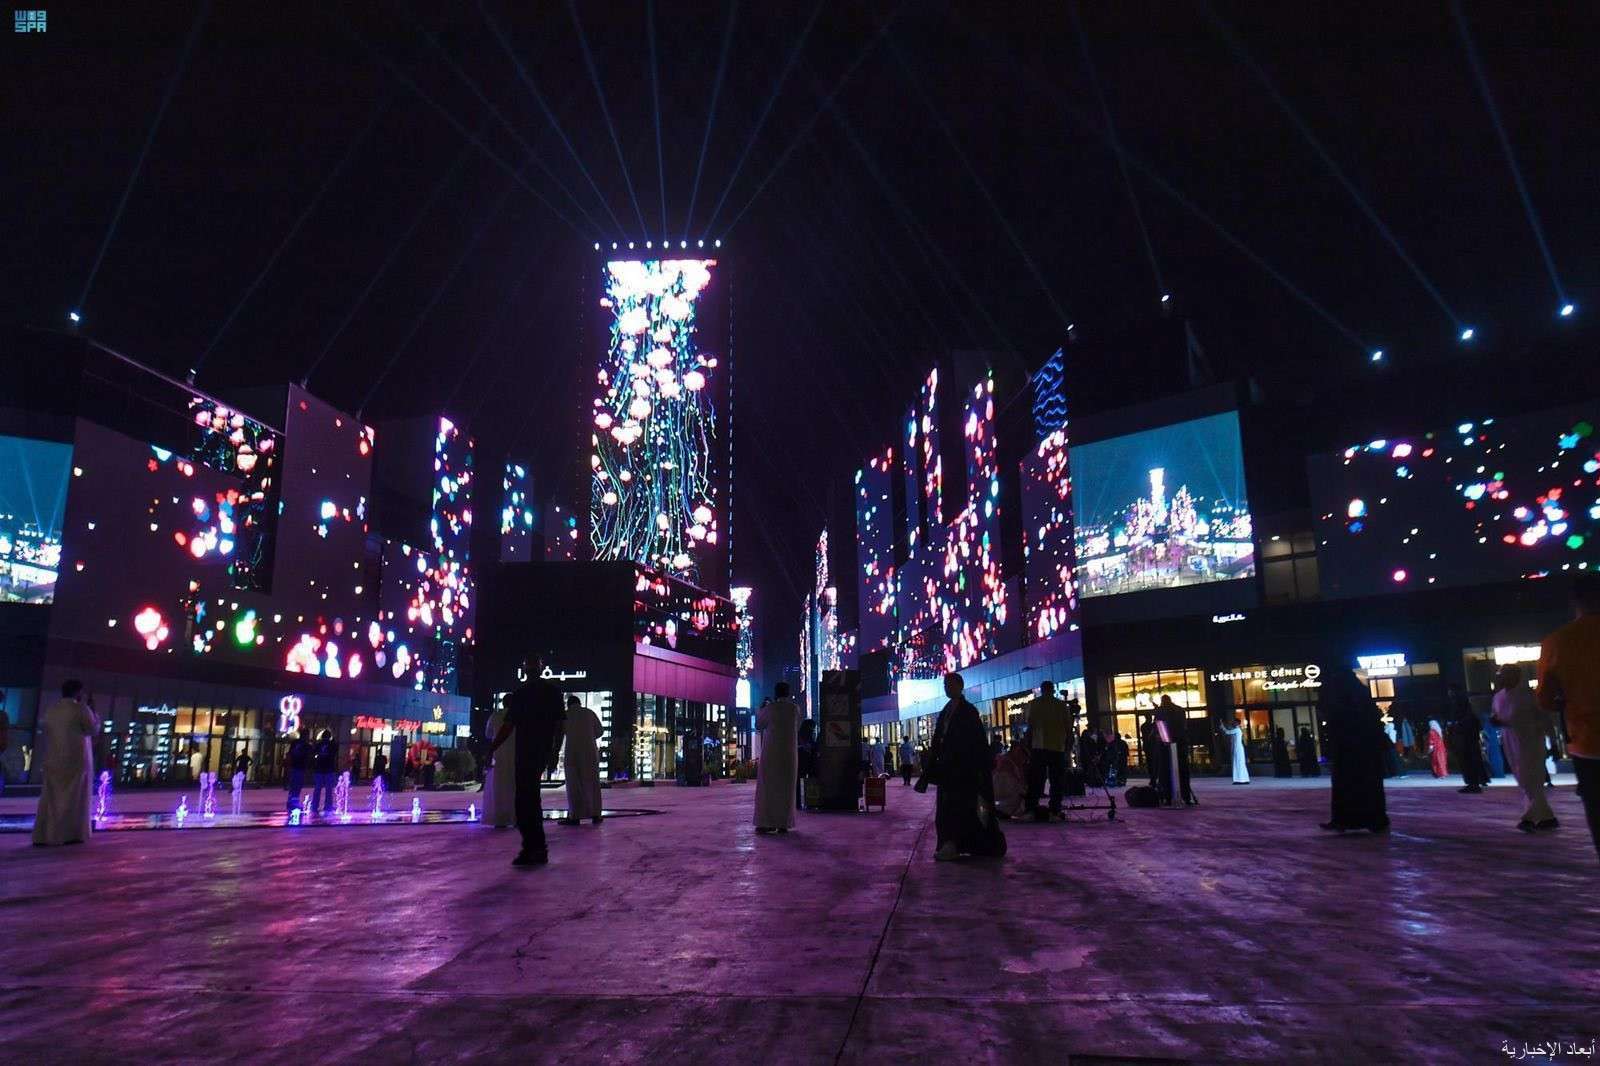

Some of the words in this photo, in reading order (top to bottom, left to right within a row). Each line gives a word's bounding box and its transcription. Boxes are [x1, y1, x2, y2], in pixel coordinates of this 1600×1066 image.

[517, 665, 587, 682] سيفرا
[1254, 670, 1268, 679] DE
[1270, 667, 1303, 678] GÉNIE
